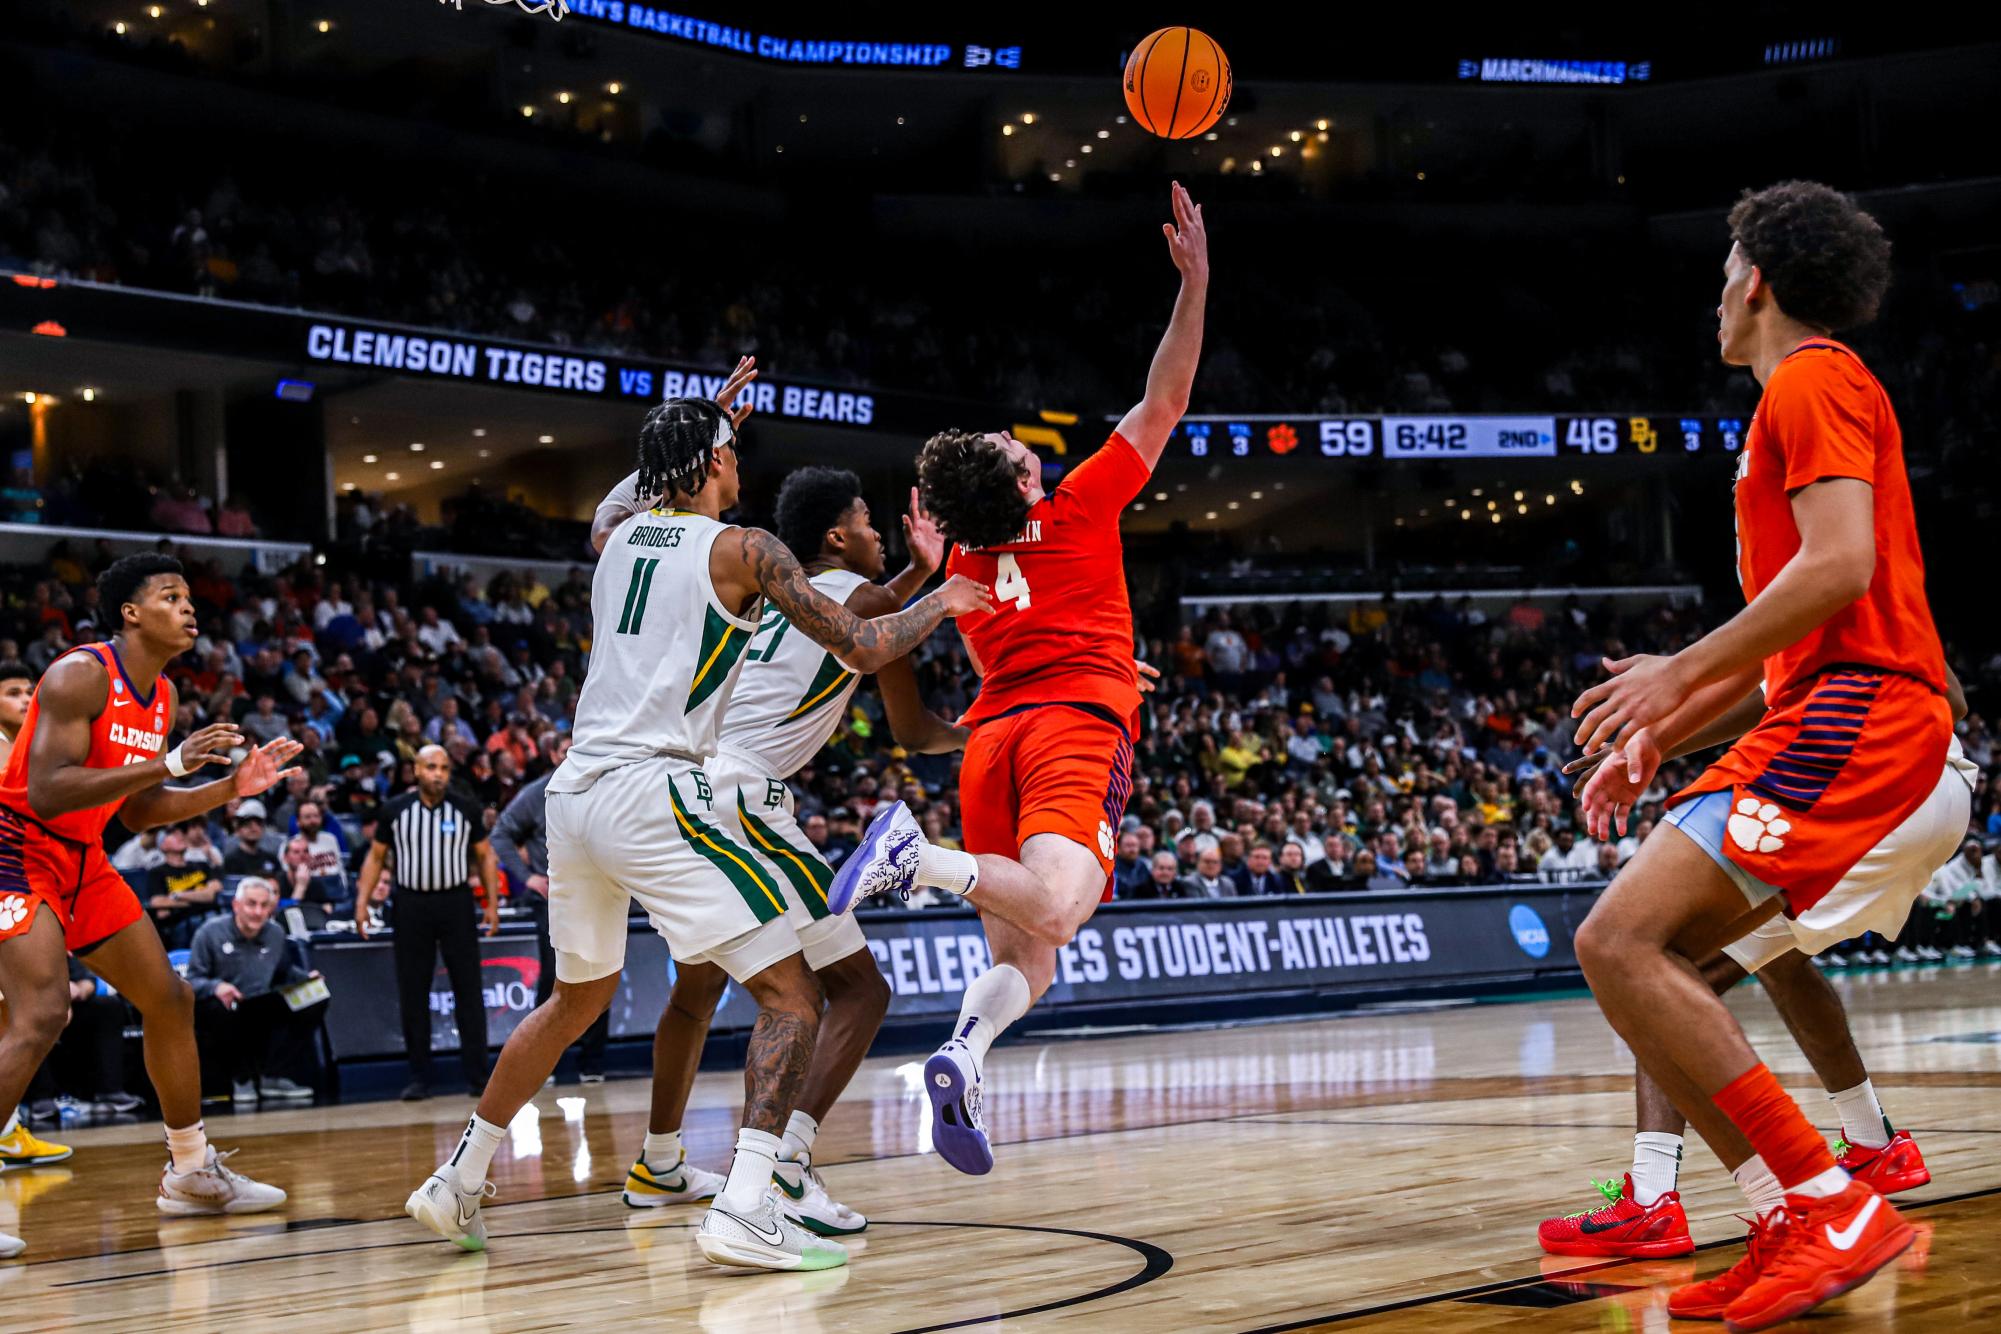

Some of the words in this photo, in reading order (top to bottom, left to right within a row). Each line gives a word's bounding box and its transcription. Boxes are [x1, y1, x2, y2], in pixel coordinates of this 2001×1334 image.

[628, 4, 754, 52] BASKETBALL
[758, 35, 951, 66] CHAMPIONSHIP
[307, 325, 477, 377] CLEMSON
[485, 347, 607, 393] TIGERS
[620, 367, 652, 396] VS
[662, 370, 777, 413] BAYOR
[783, 386, 875, 425] BEARS
[1232, 436, 1249, 456] 3
[1319, 421, 1373, 456] 59
[1395, 423, 1468, 451] 6:42
[1498, 431, 1539, 449] 2ND
[1566, 419, 1618, 454] 46
[627, 526, 686, 548] BRIDGES
[616, 557, 661, 636] 11
[995, 552, 1031, 611] 4
[109, 722, 164, 752] CLEMSON
[1113, 912, 1431, 980] STUDENT-ATHLETES
